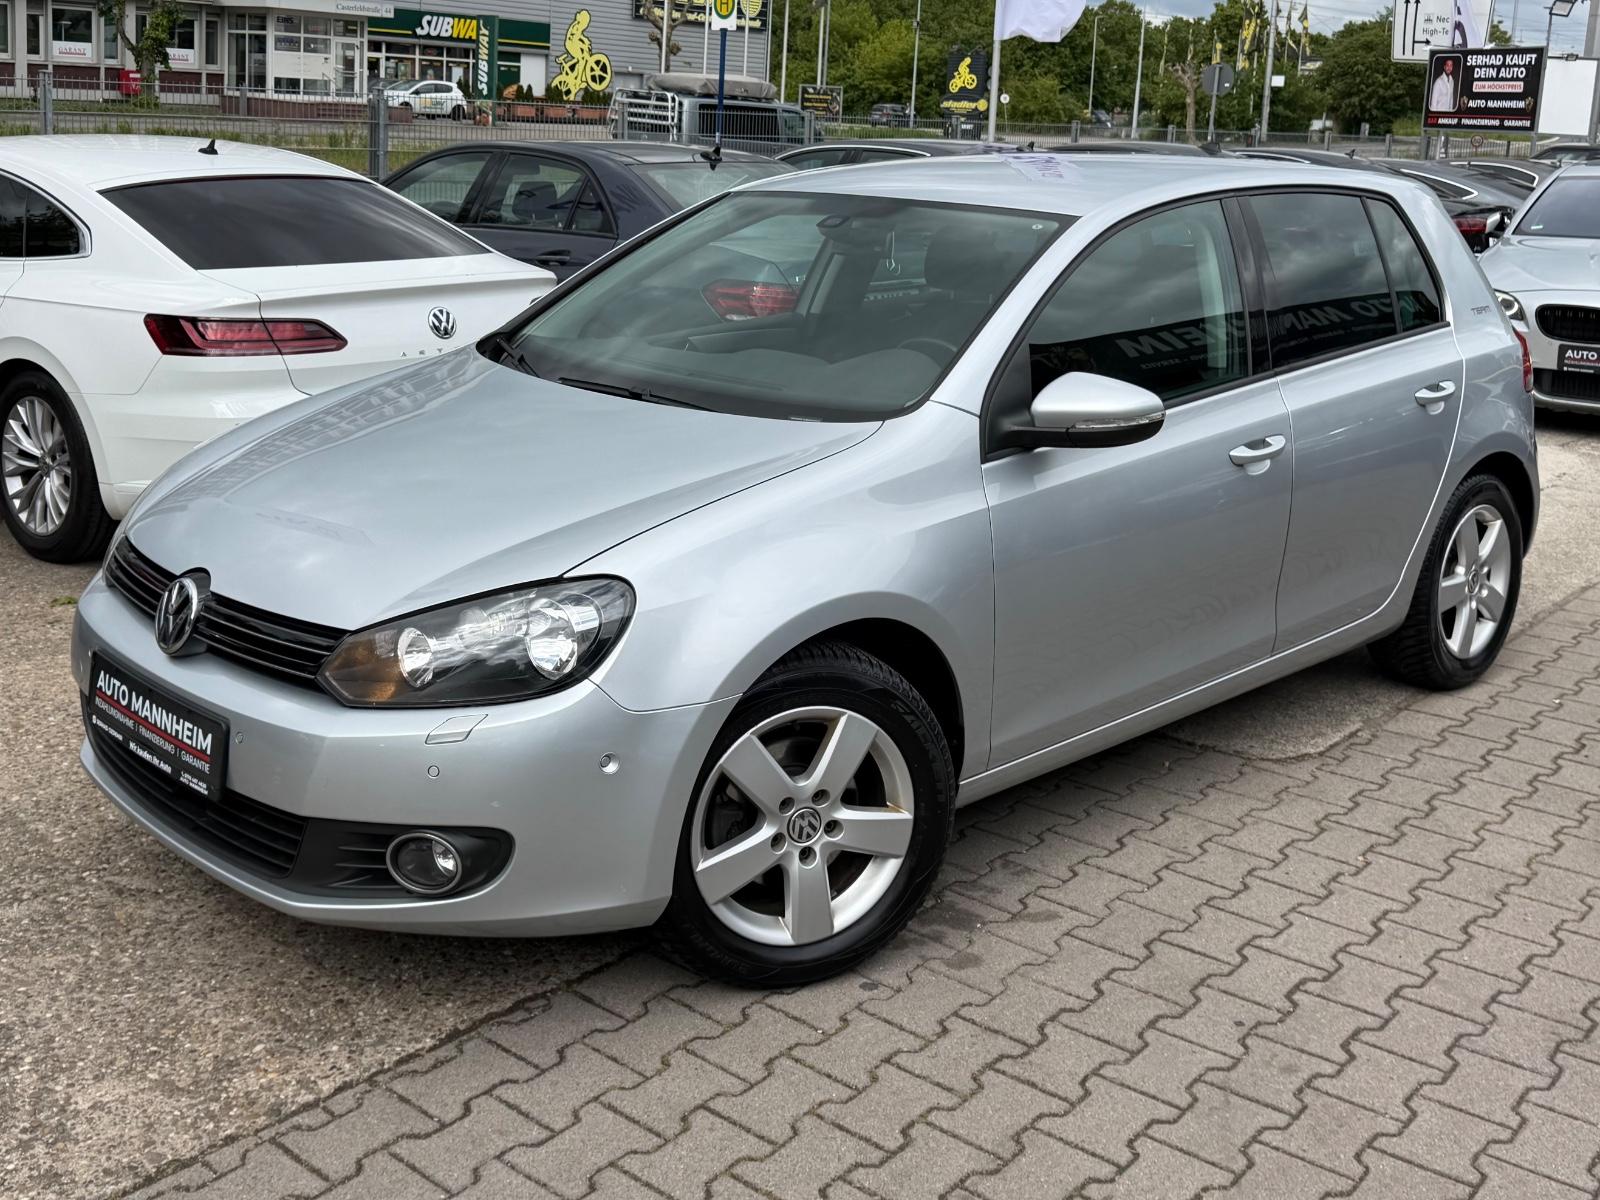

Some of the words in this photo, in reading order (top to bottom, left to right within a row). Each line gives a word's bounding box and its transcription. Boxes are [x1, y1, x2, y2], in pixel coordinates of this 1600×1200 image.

[415, 14, 477, 40] SUBWA
[1422, 28, 1449, 36] High-Te
[169, 52, 189, 60] ARANT
[477, 19, 489, 96] SUBWAY
[1466, 54, 1503, 66] SERHAD
[1505, 54, 1537, 65] KAUFT
[1473, 67, 1497, 78] DEIN
[1498, 67, 1526, 78] AUTO
[940, 99, 977, 109] stadler
[1468, 99, 1486, 108] AUTO
[1487, 100, 1525, 109] MANNHEIM
[1461, 118, 1500, 126] FINANZIERUNG
[1503, 119, 1531, 127] GARANTIE
[400, 348, 443, 358] ART
[1565, 349, 1597, 360] AUTO
[96, 670, 129, 705] AUTO
[131, 691, 212, 755] MANNHEIM
[138, 725, 175, 754] FINANZIERUNG
[180, 751, 210, 774] GARANTIE
[129, 740, 137, 751] Wir
[137, 747, 152, 761] kaufen
[159, 760, 172, 774] Auto
